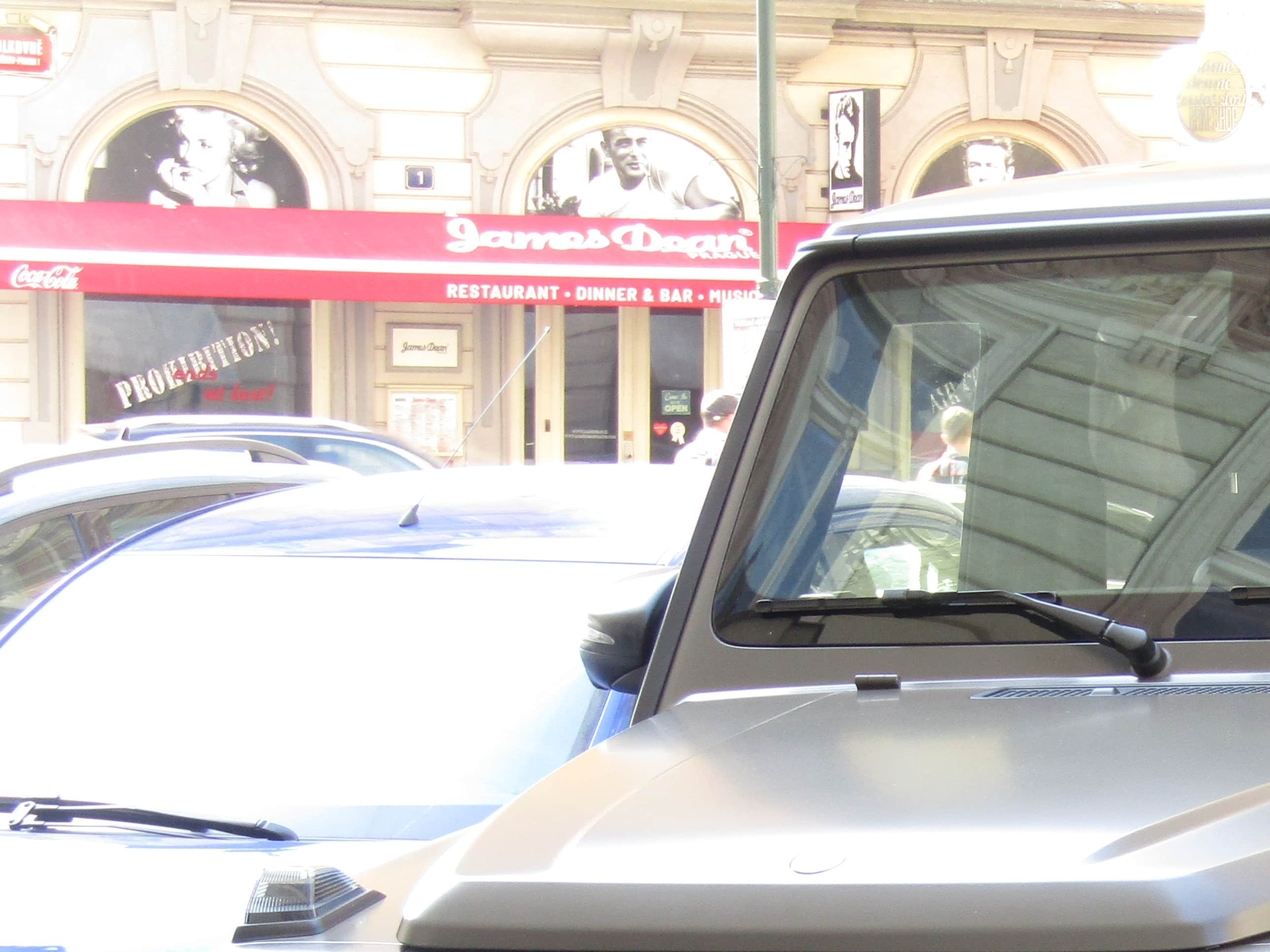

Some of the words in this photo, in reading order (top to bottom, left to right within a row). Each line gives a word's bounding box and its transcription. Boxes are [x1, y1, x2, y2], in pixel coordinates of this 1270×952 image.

[416, 170, 424, 185] 1
[447, 218, 610, 253] James
[611, 223, 753, 253] Dean
[10, 264, 84, 290] Coca-Cola
[447, 283, 560, 301] RESTAURANT
[576, 286, 638, 302] DINNER
[643, 287, 655, 302] &
[660, 288, 693, 303] BAR
[401, 342, 426, 354] James
[427, 342, 448, 352] Dean
[115, 320, 280, 409] PROHIBITION!
[664, 404, 688, 413] OPEN
